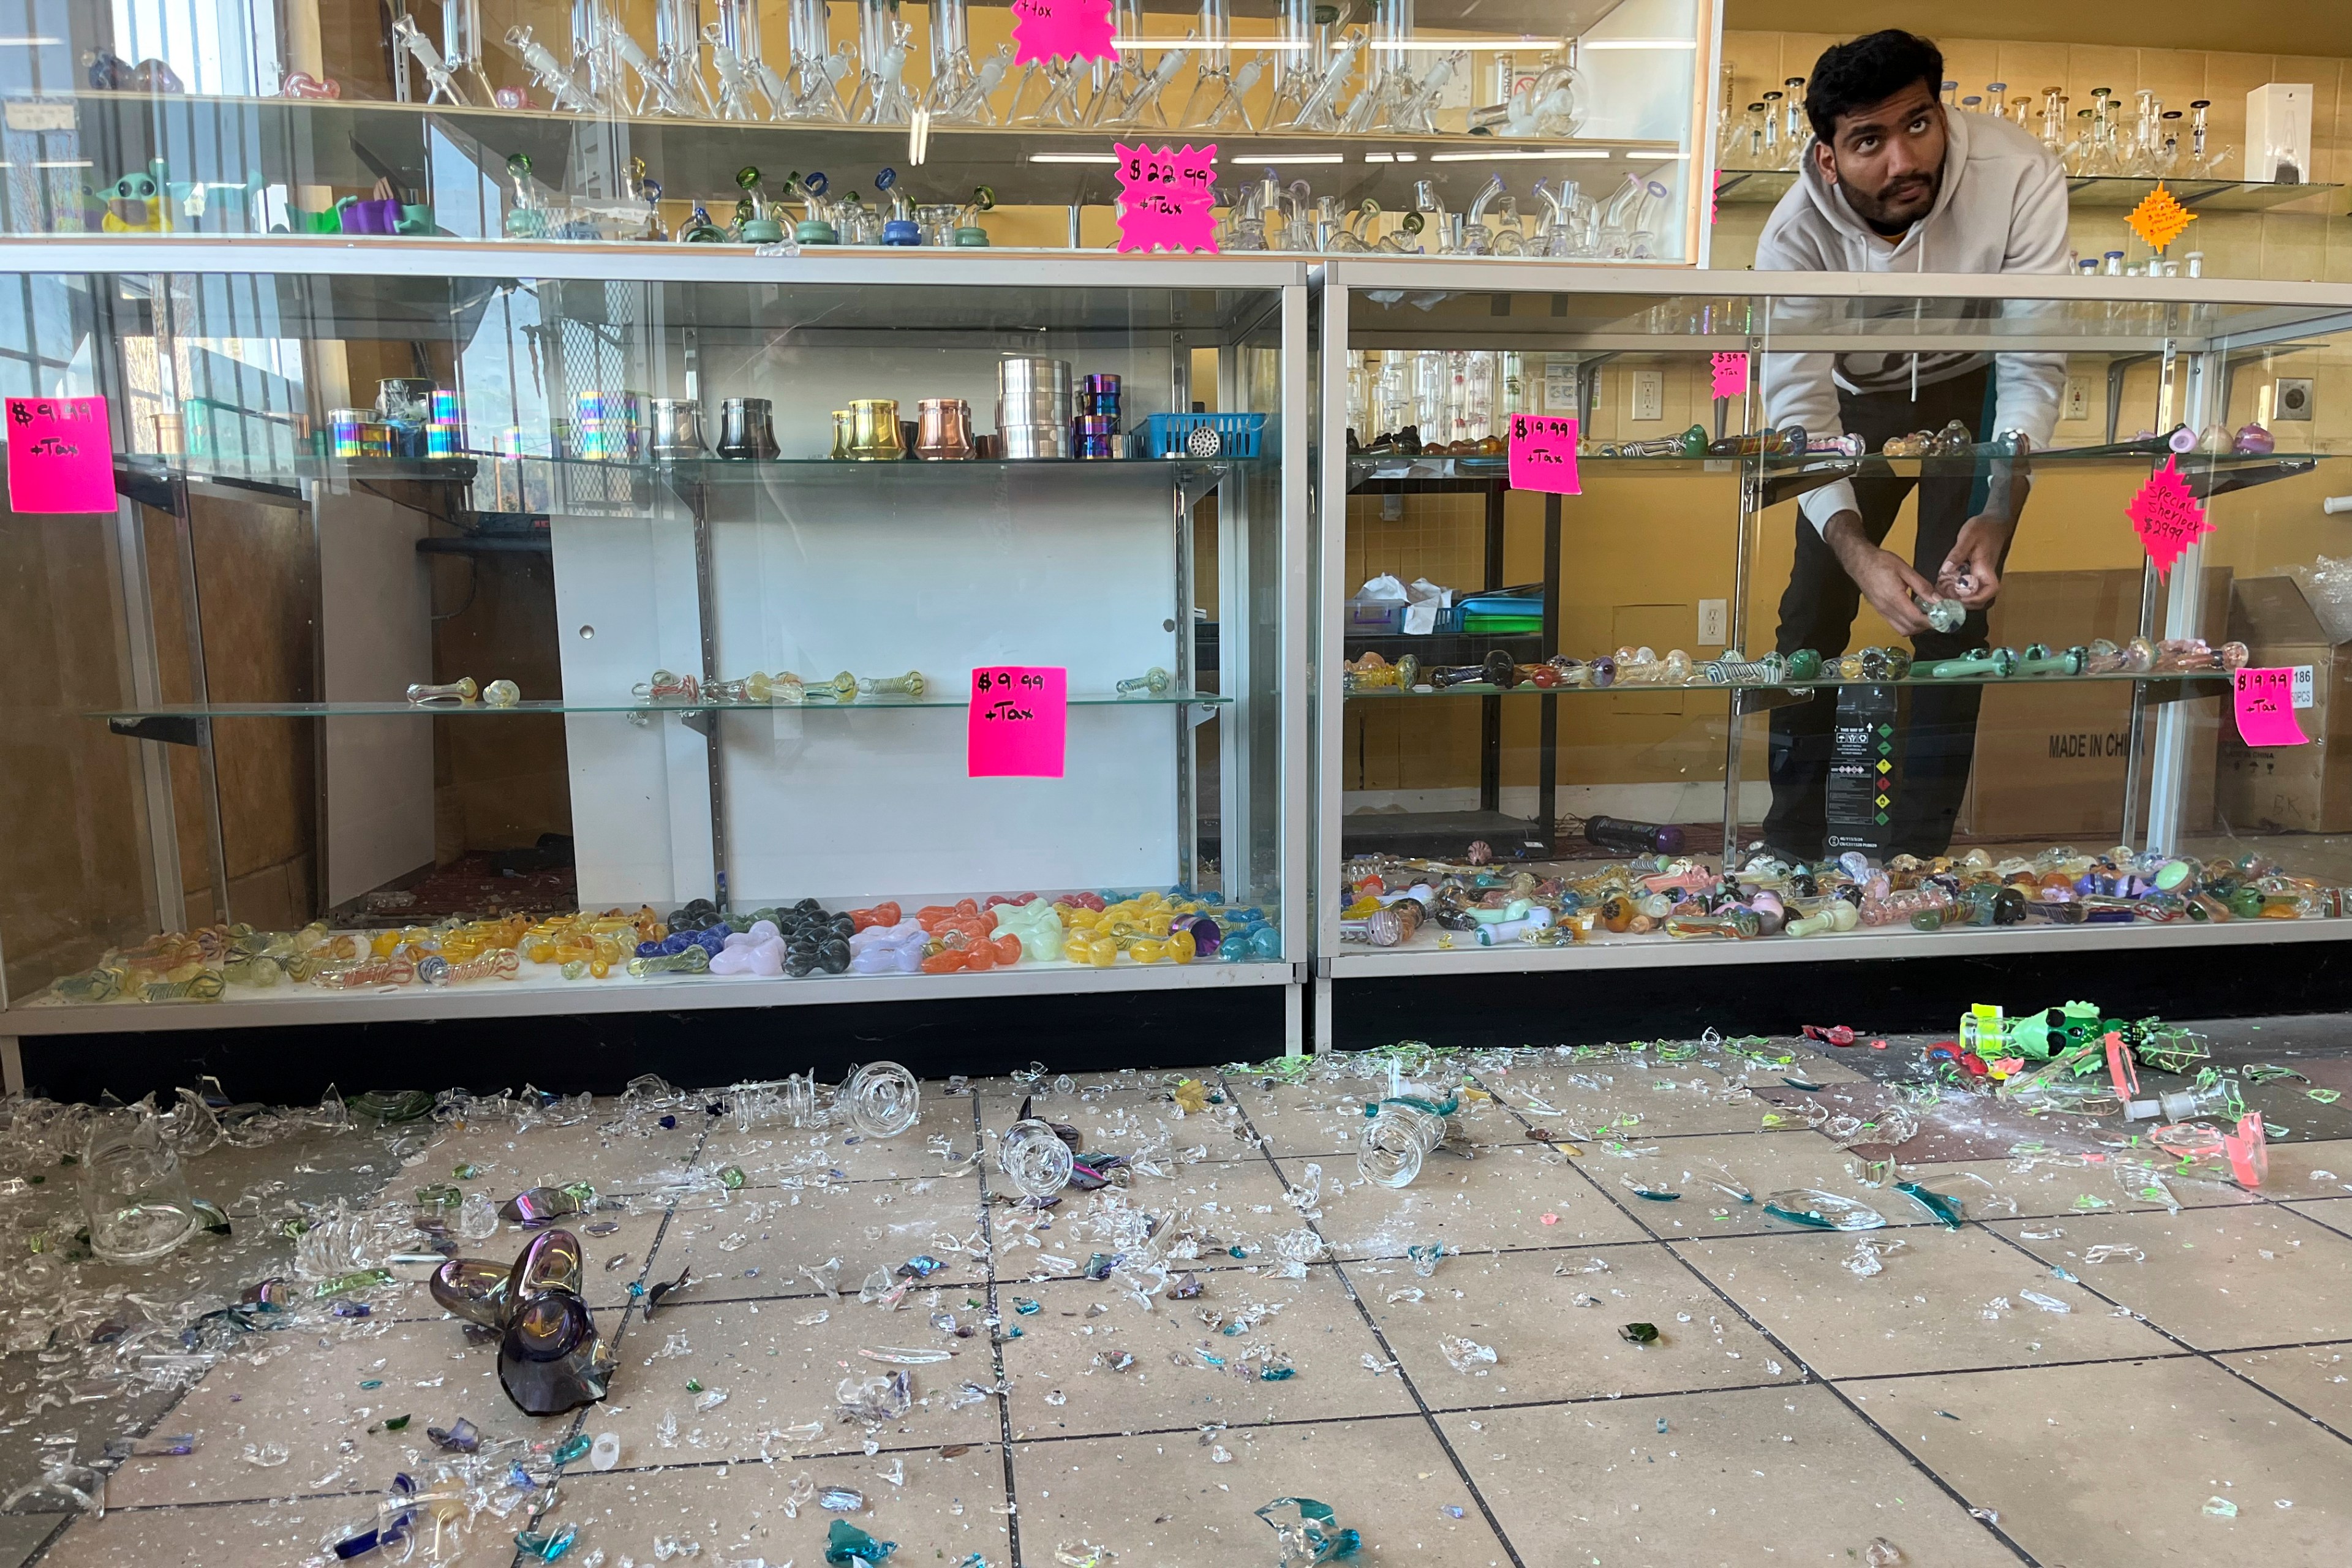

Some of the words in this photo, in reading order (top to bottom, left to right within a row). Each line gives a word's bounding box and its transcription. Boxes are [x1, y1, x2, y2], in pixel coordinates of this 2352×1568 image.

[2049, 734, 2086, 758] MADE
[2089, 734, 2103, 758] IN
[2106, 733, 2145, 757] CHI
